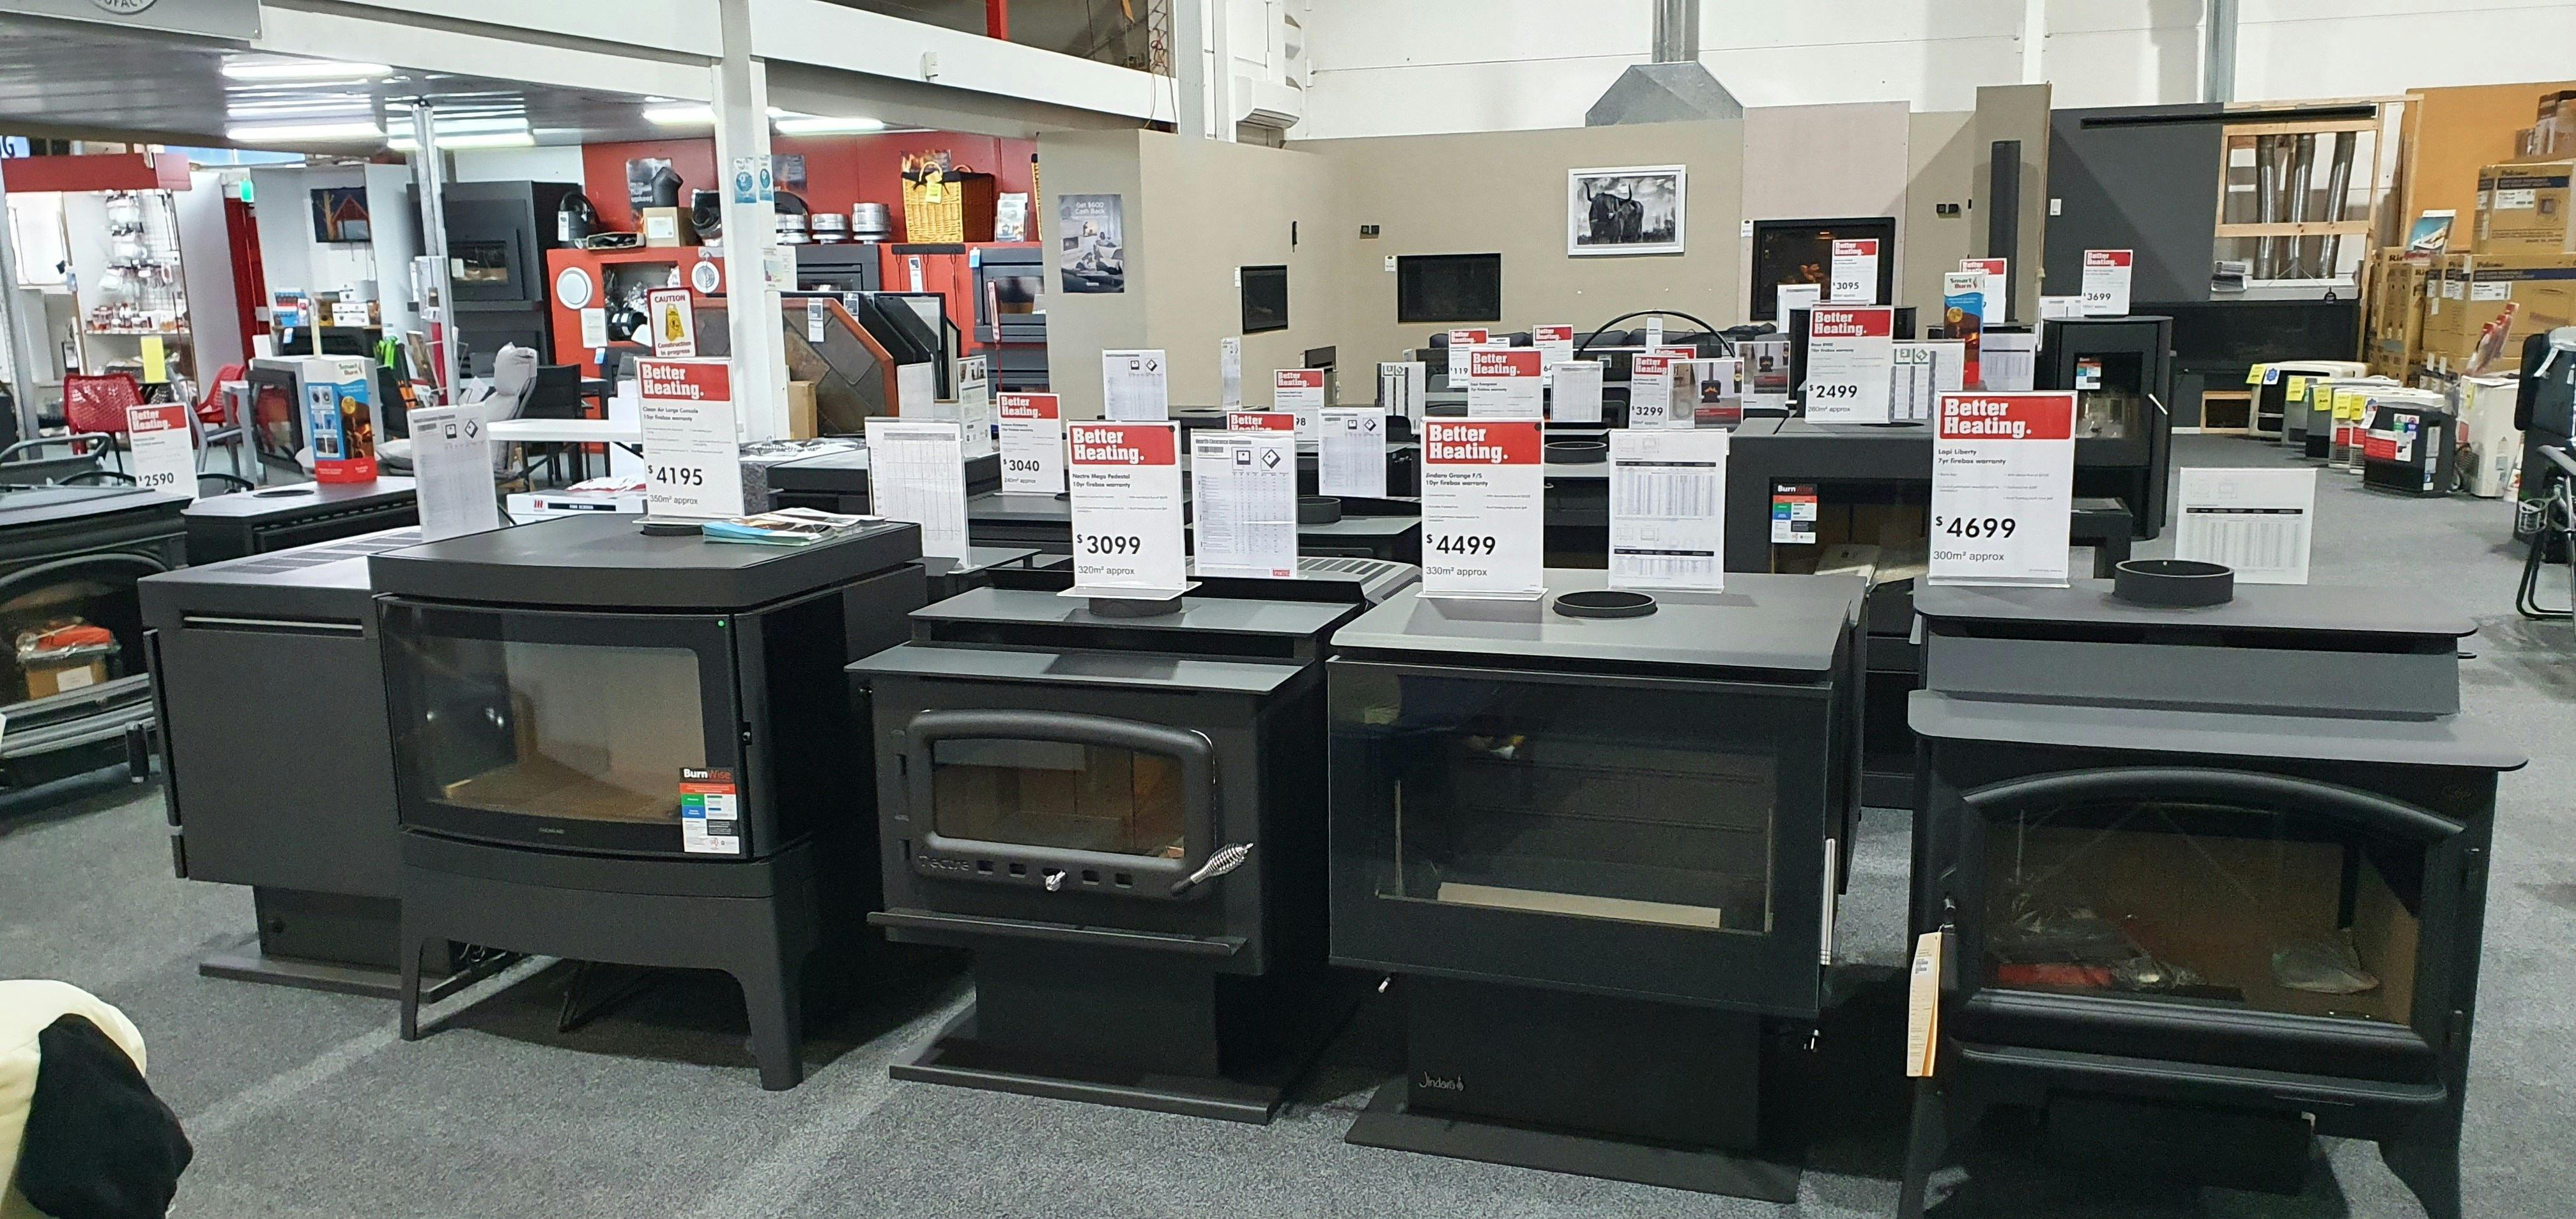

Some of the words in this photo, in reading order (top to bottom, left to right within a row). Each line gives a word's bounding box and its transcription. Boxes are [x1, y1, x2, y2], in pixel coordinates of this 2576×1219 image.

[654, 295, 686, 303] CAUTION
[1815, 311, 1854, 323] Better
[1814, 323, 1867, 336] Heating.
[1473, 353, 1508, 364] Better
[1635, 357, 1662, 366] Better
[641, 364, 686, 380] Better
[1278, 371, 1301, 379] Better
[1473, 363, 1521, 376] Heating.
[1278, 379, 1310, 387] Heating.
[643, 379, 704, 400] Heating.
[1000, 396, 1031, 407] Better
[1945, 397, 2009, 416] Better
[131, 410, 160, 422] Better
[1001, 406, 1042, 418] Heating.
[132, 419, 172, 431] Heating.
[1230, 414, 1264, 425] Better
[1429, 424, 1487, 441] Better
[1943, 417, 2032, 439] Heating.
[1072, 427, 1124, 444] Better
[1073, 444, 1145, 464] Heating.
[1429, 442, 1508, 464] Heating.
[673, 496, 698, 506] approx
[1933, 551, 1966, 560] 300m²
[1969, 553, 2005, 562] approx
[1078, 565, 1105, 574] 320m²
[1107, 568, 1135, 576] approx
[1426, 566, 1455, 576] 330m²
[1457, 569, 1488, 577] approx
[1418, 1070, 1457, 1090] Jindara
